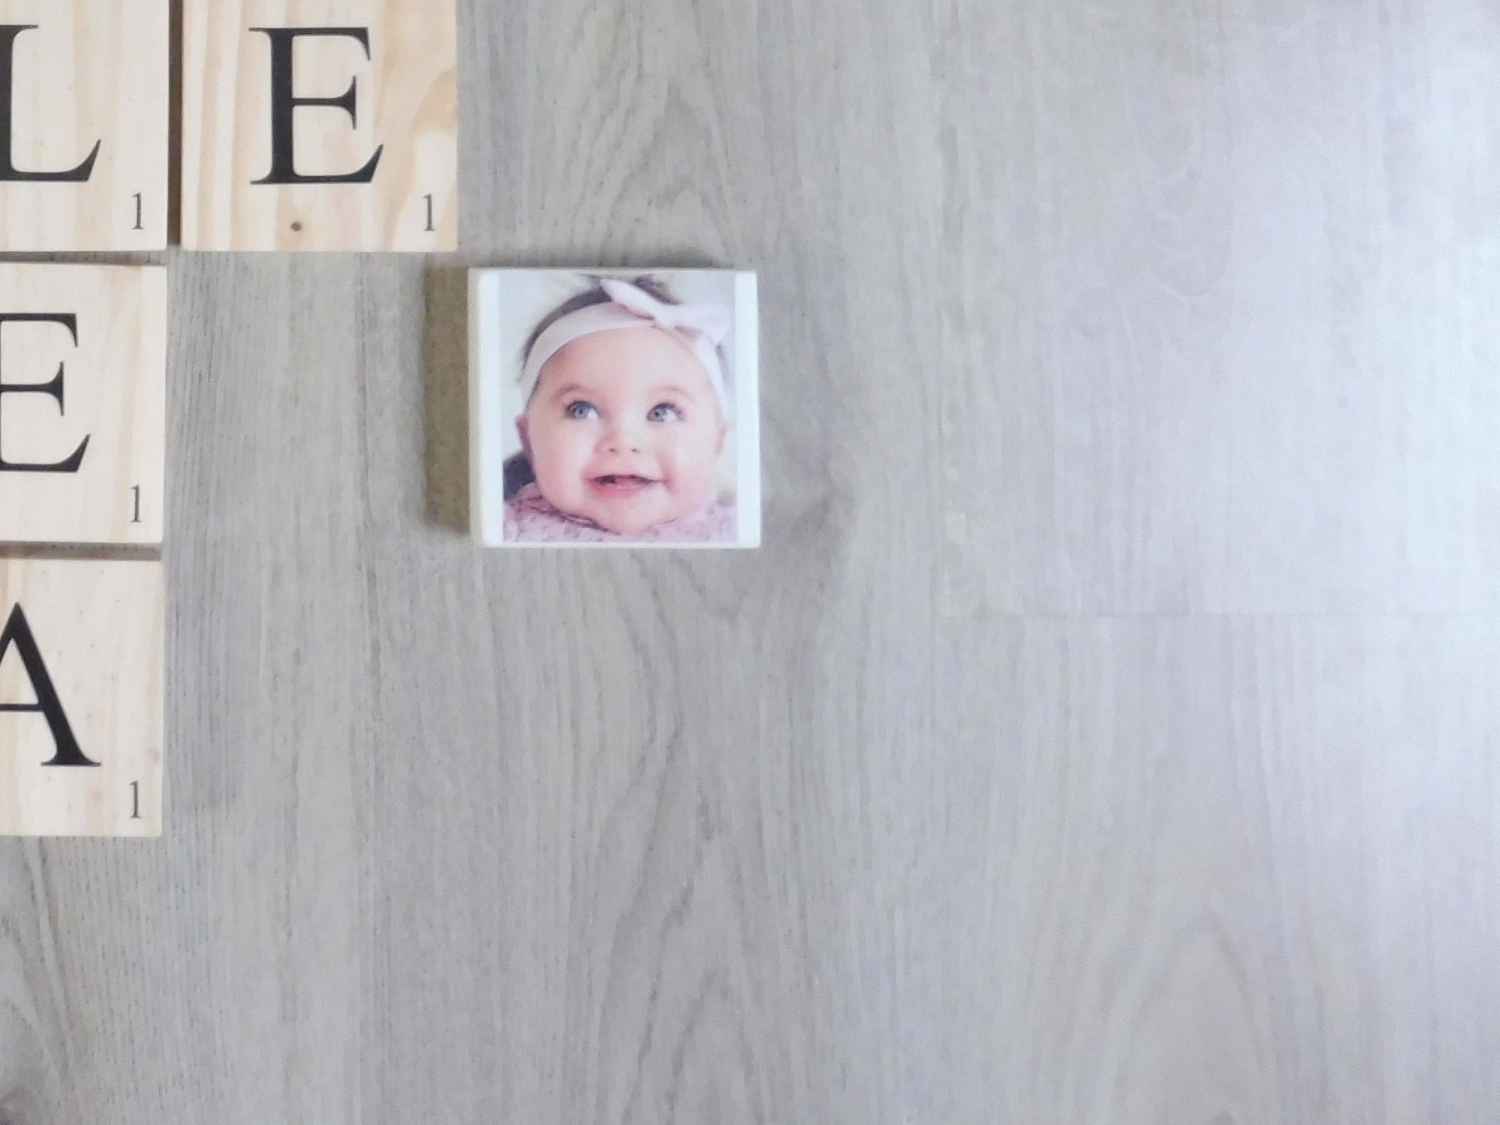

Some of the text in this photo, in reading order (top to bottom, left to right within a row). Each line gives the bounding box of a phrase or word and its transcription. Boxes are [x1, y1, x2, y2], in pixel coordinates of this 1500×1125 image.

[131, 192, 145, 231] 1
[423, 193, 436, 232] 1
[129, 484, 142, 523] 1
[128, 780, 142, 820] 1
